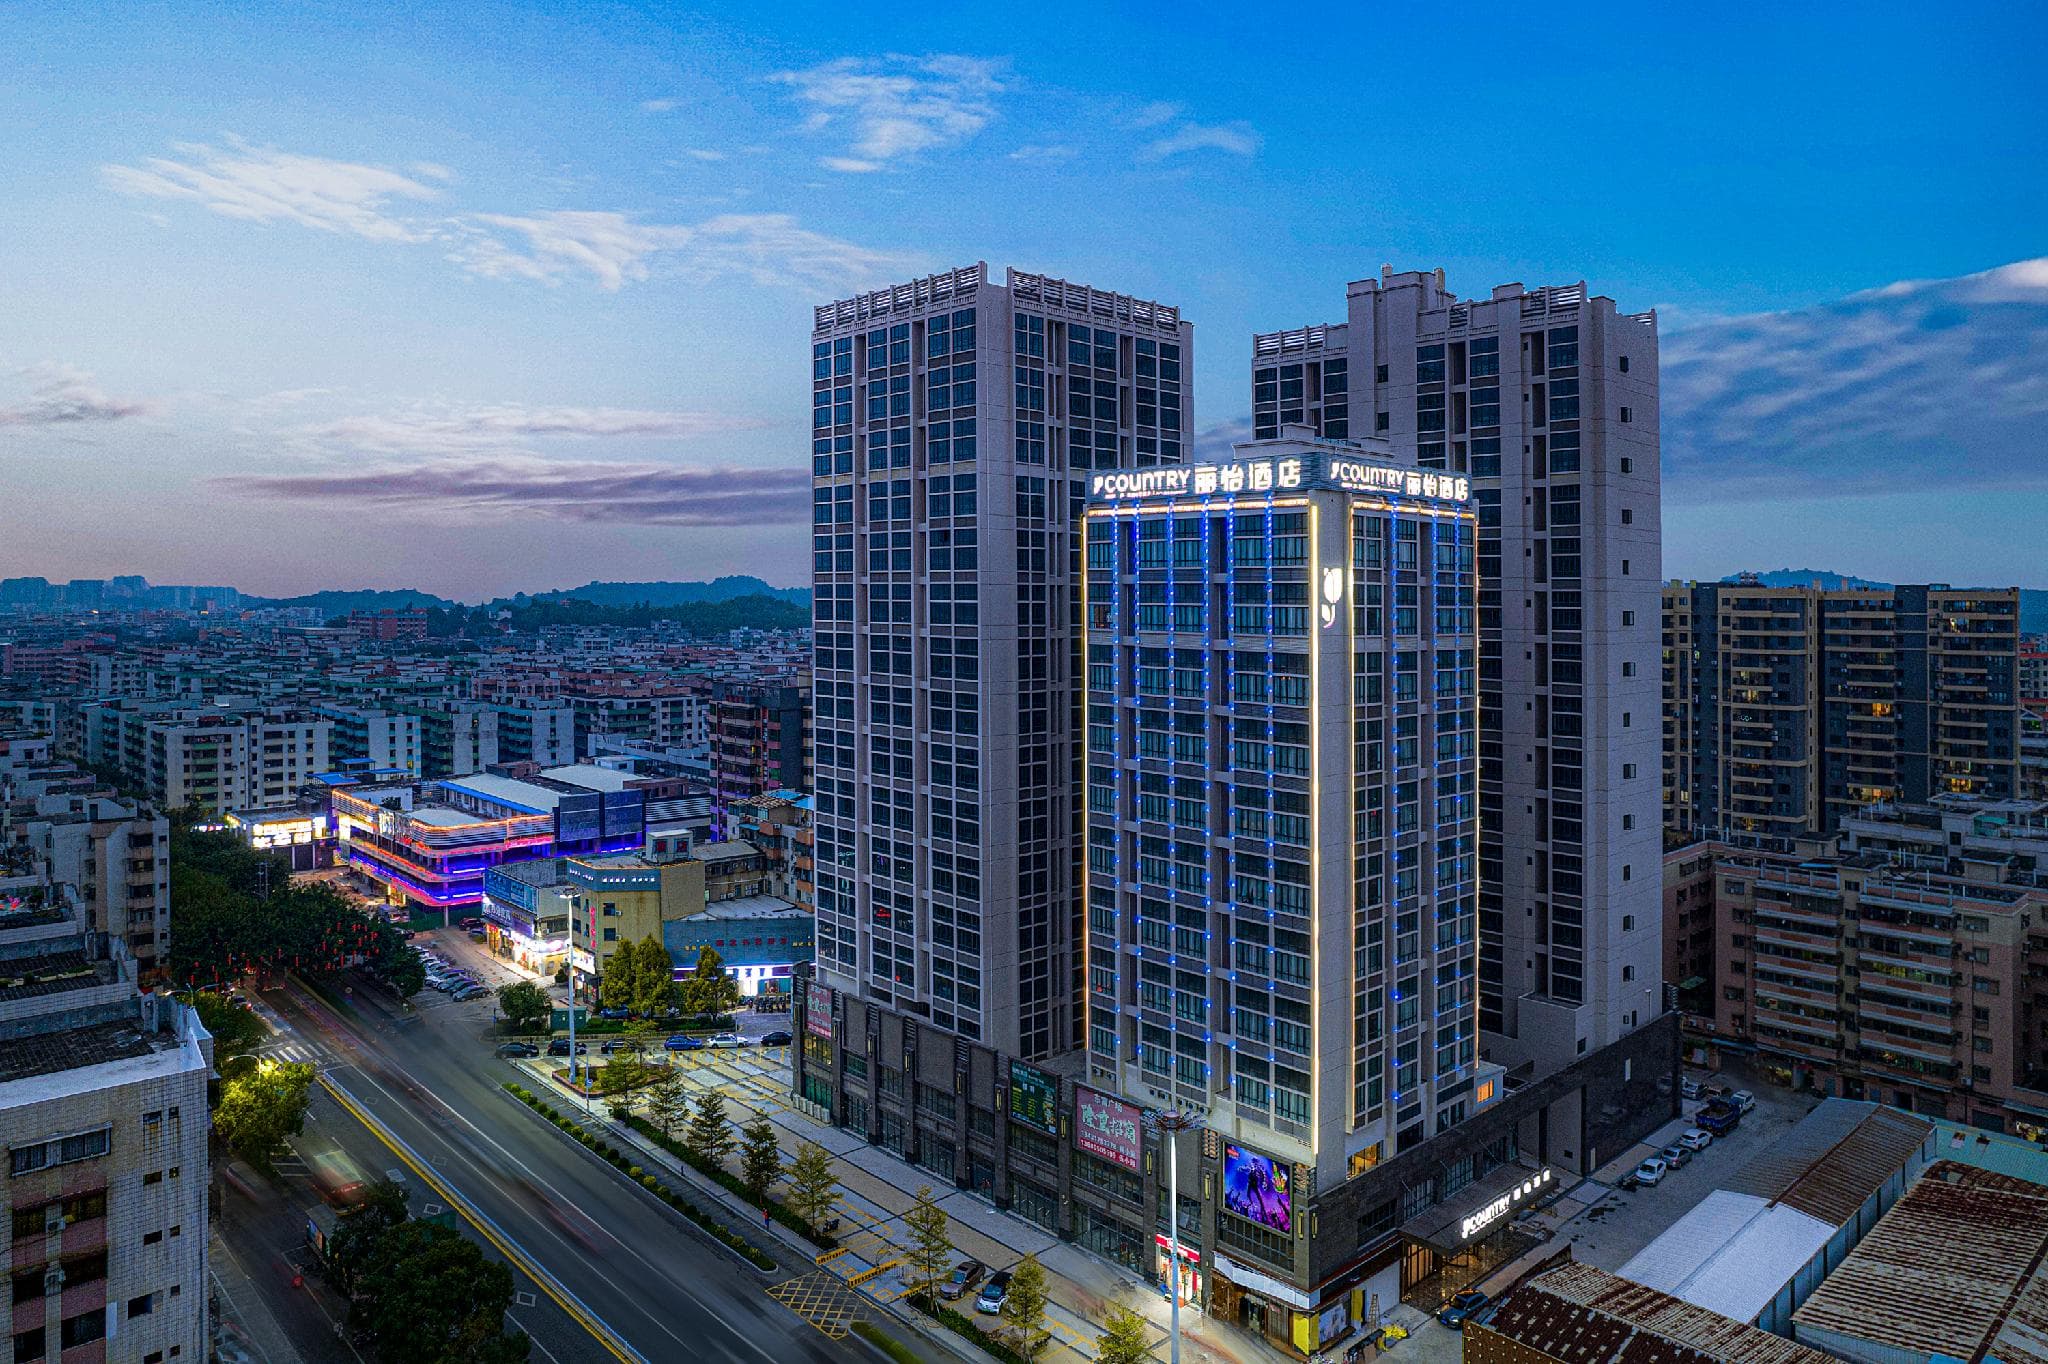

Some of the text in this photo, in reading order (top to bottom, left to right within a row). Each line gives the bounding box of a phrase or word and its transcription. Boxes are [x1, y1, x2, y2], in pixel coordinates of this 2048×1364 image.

[1104, 459, 1301, 494] COUNTRY 丽怡酒店
[1340, 462, 1469, 502] COUNTRY 丽怡酒店
[1081, 1104, 1136, 1145] 隆重招商
[1469, 1193, 1511, 1229] COUNTRY
